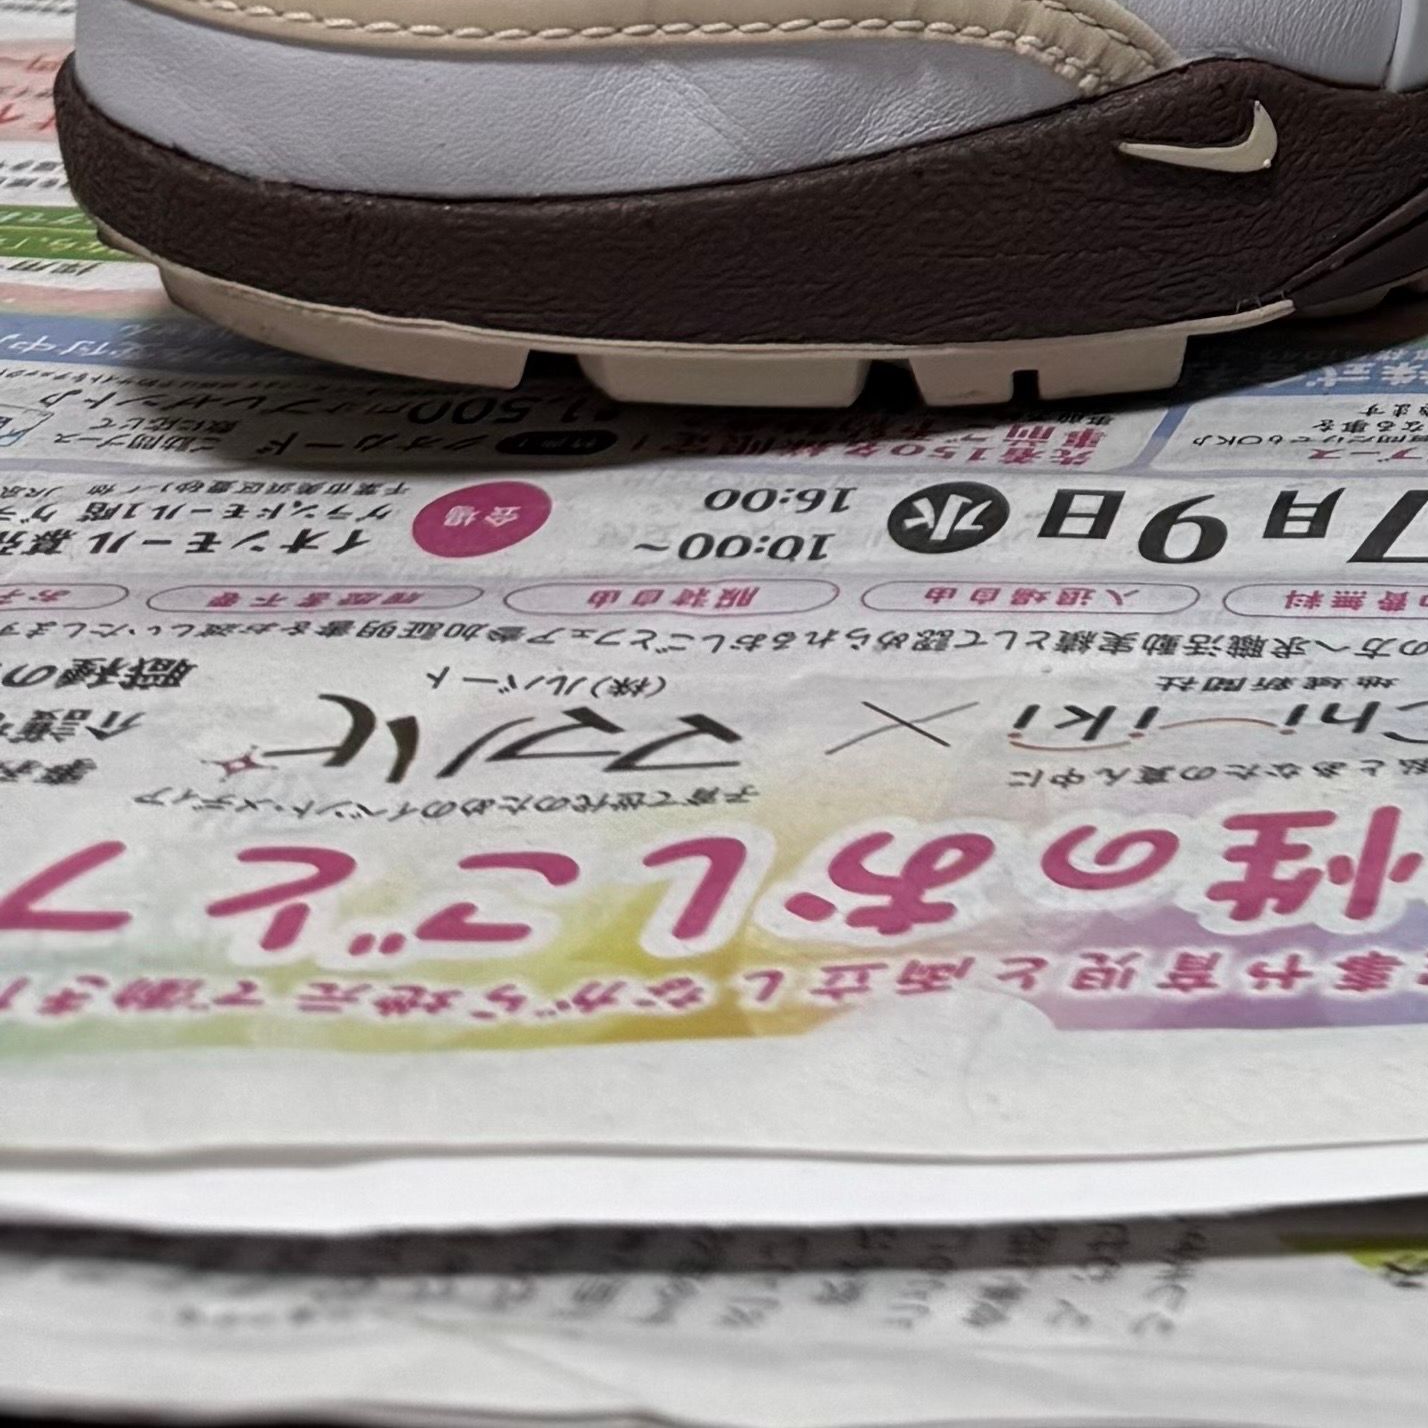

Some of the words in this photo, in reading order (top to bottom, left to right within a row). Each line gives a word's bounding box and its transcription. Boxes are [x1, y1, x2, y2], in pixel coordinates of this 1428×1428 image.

[702, 486, 859, 514] 16:00
[442, 505, 522, 527] 会場
[902, 492, 990, 540] 水
[584, 586, 761, 609] 服装自由
[922, 586, 1142, 608] 入退場自由
